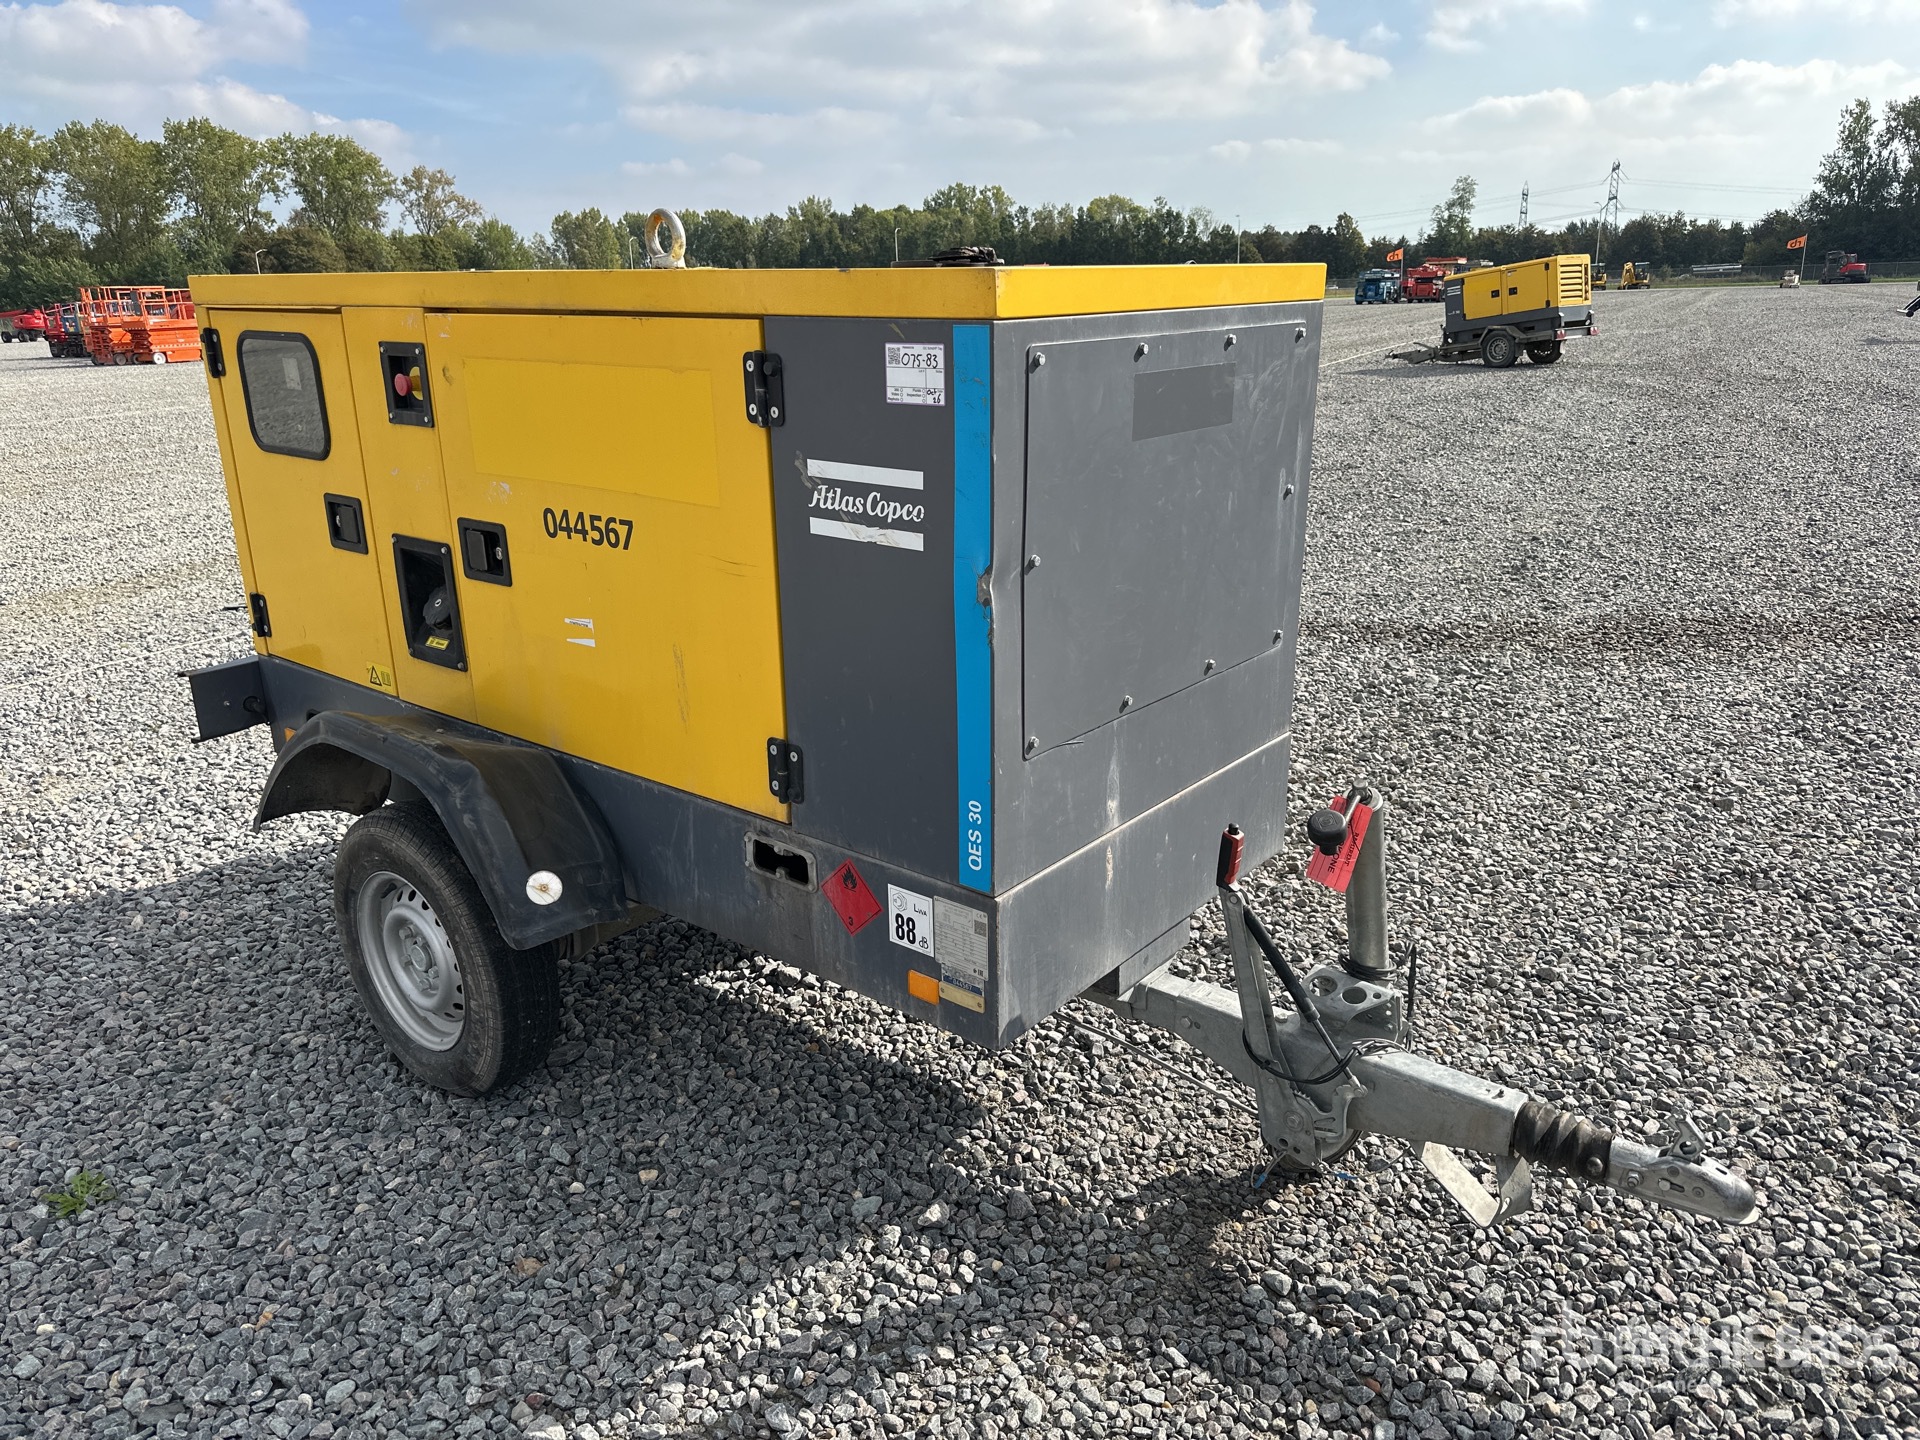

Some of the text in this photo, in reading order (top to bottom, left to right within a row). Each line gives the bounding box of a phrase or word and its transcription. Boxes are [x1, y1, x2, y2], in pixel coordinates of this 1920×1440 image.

[901, 352, 938, 369] 075-83
[808, 485, 925, 523] Atlas Copco
[543, 507, 634, 551] 044567
[968, 800, 982, 871] QES 30
[848, 916, 854, 926] 3
[895, 912, 916, 944] 88
[918, 936, 929, 949] dB
